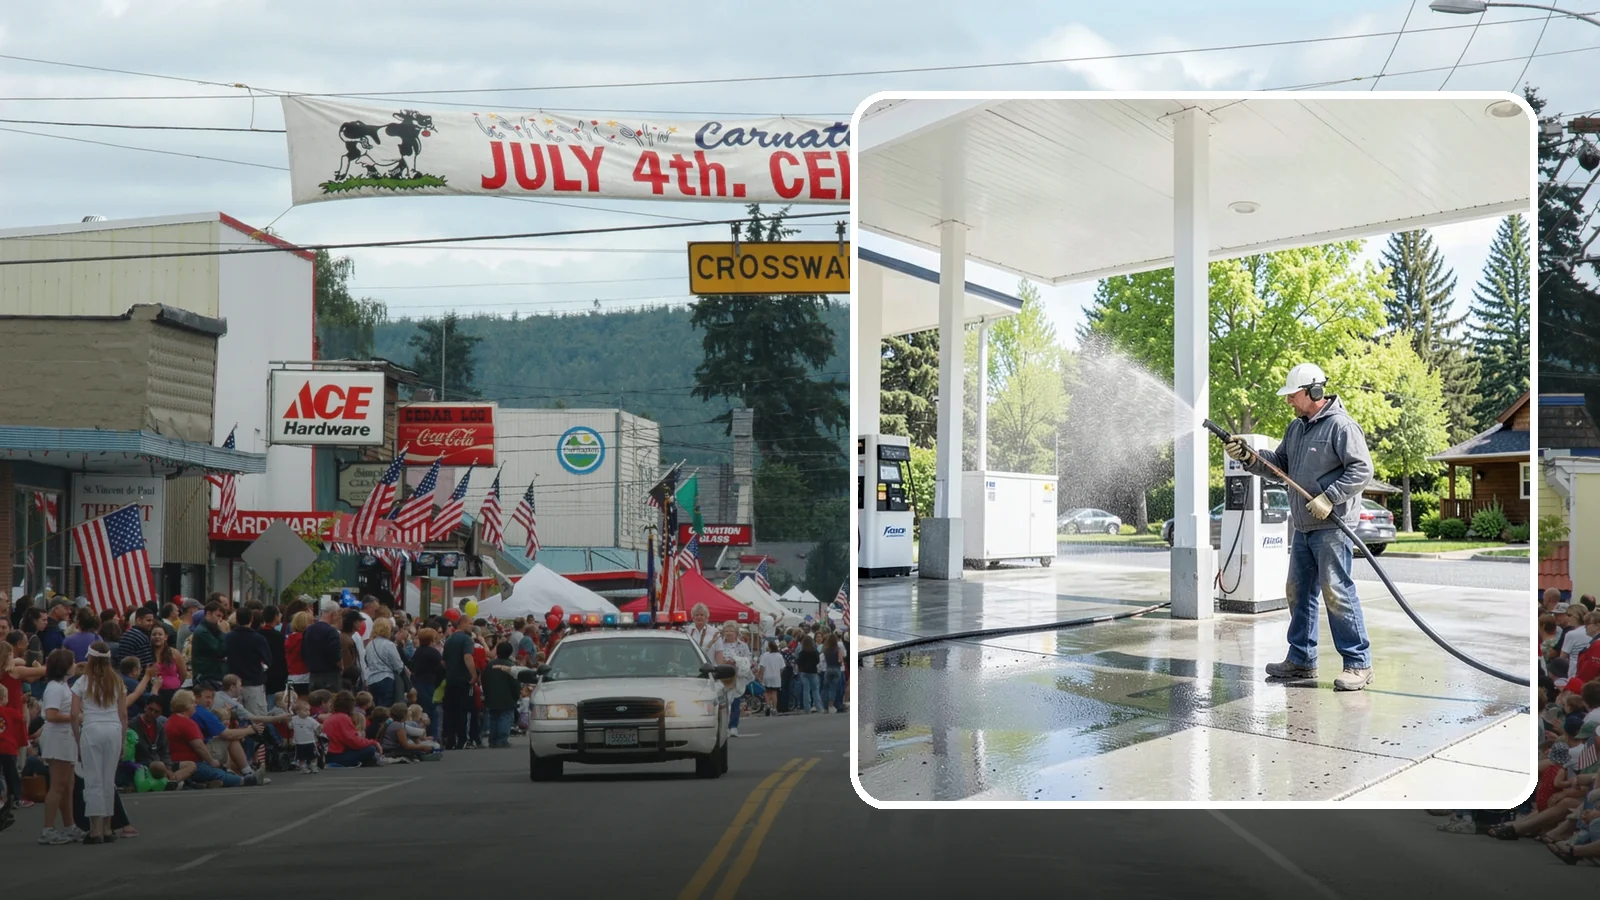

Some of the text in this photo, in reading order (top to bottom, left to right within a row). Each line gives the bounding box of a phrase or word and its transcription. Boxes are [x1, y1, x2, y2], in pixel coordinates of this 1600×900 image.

[481, 141, 605, 193] JULY
[632, 150, 746, 198] 4th.
[697, 254, 850, 280] CROSSWA
[282, 380, 374, 420] ACE
[405, 409, 453, 422] CEDAR
[283, 421, 371, 436] Hardware
[416, 428, 477, 447] Coca-Cola
[353, 467, 386, 481] Simpl
[95, 485, 124, 495] Vincent
[126, 486, 136, 495] de
[138, 486, 155, 495] Paul
[212, 516, 331, 535] HARDARE
[688, 527, 741, 535] CRNATION
[699, 535, 730, 543] GLASS
